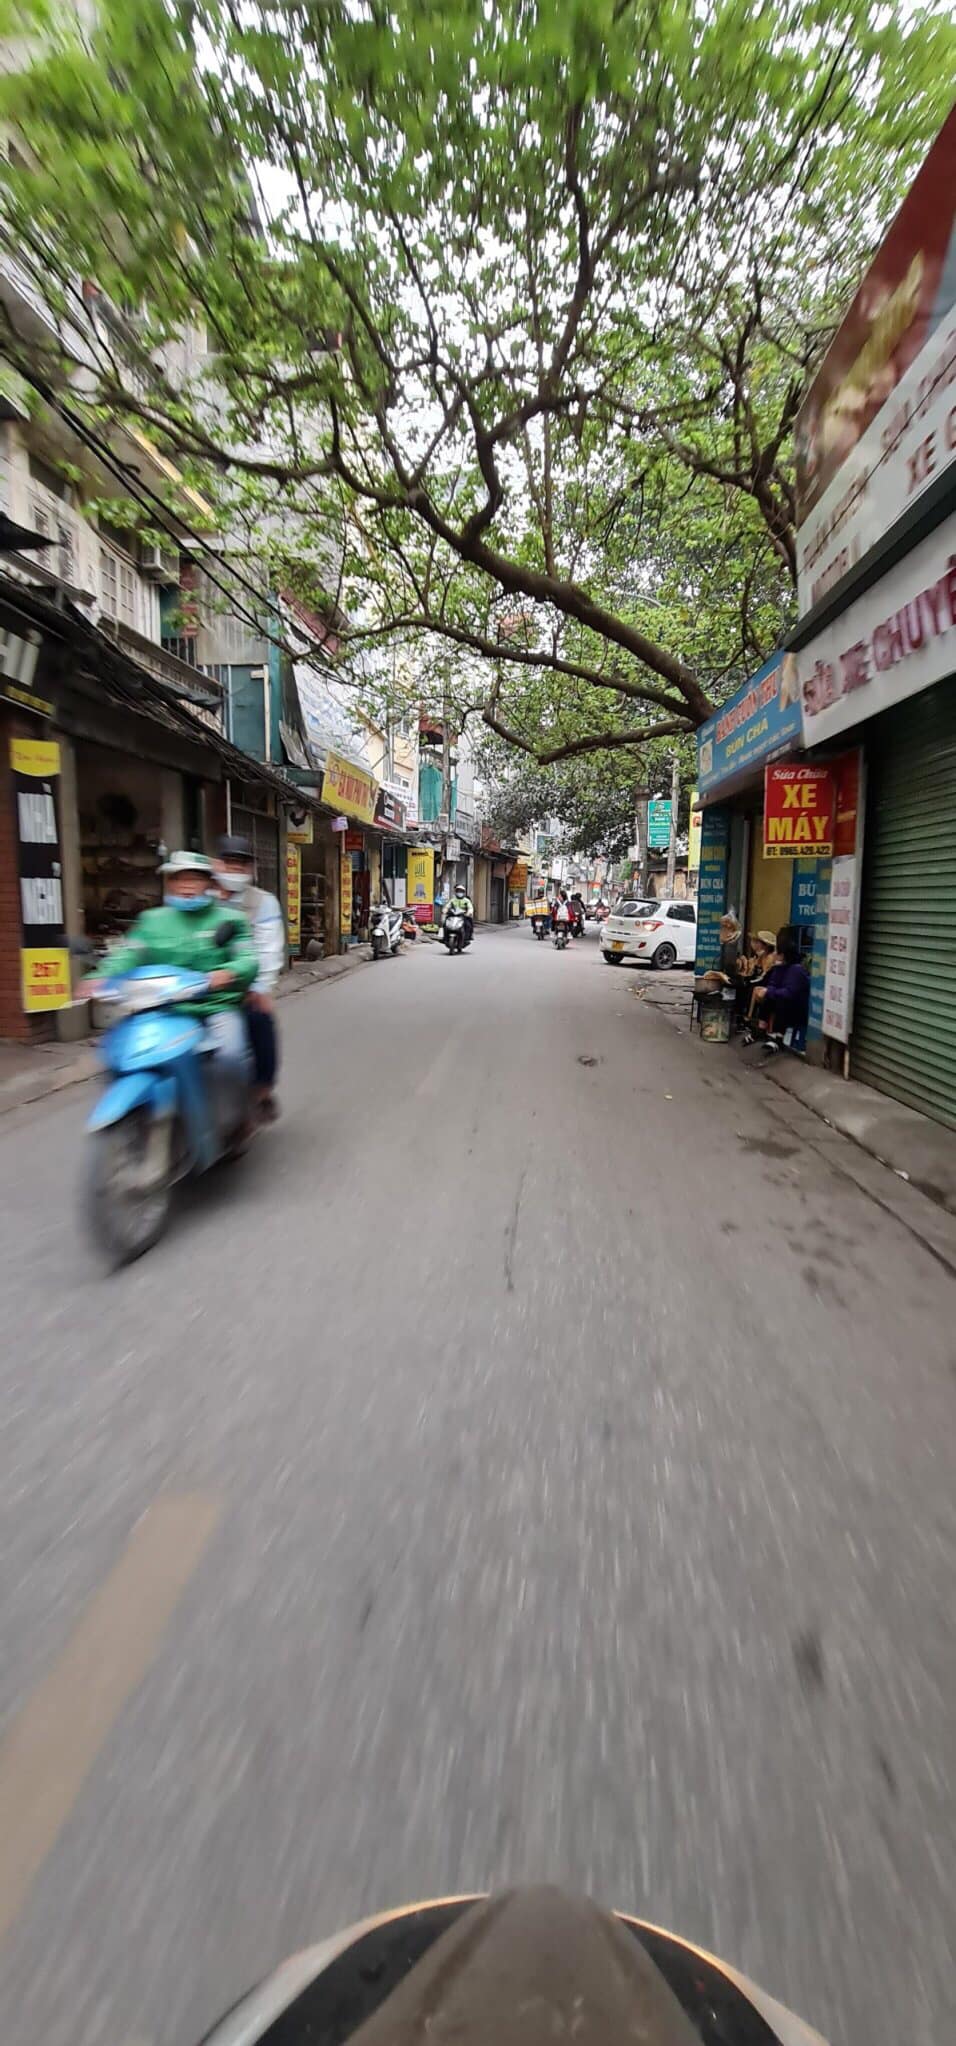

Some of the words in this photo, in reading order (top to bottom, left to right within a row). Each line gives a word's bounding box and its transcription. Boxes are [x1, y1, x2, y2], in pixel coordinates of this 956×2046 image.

[906, 431, 937, 494] XE
[839, 640, 869, 694] XE
[782, 784, 817, 808] XE
[768, 812, 829, 841] MÁY
